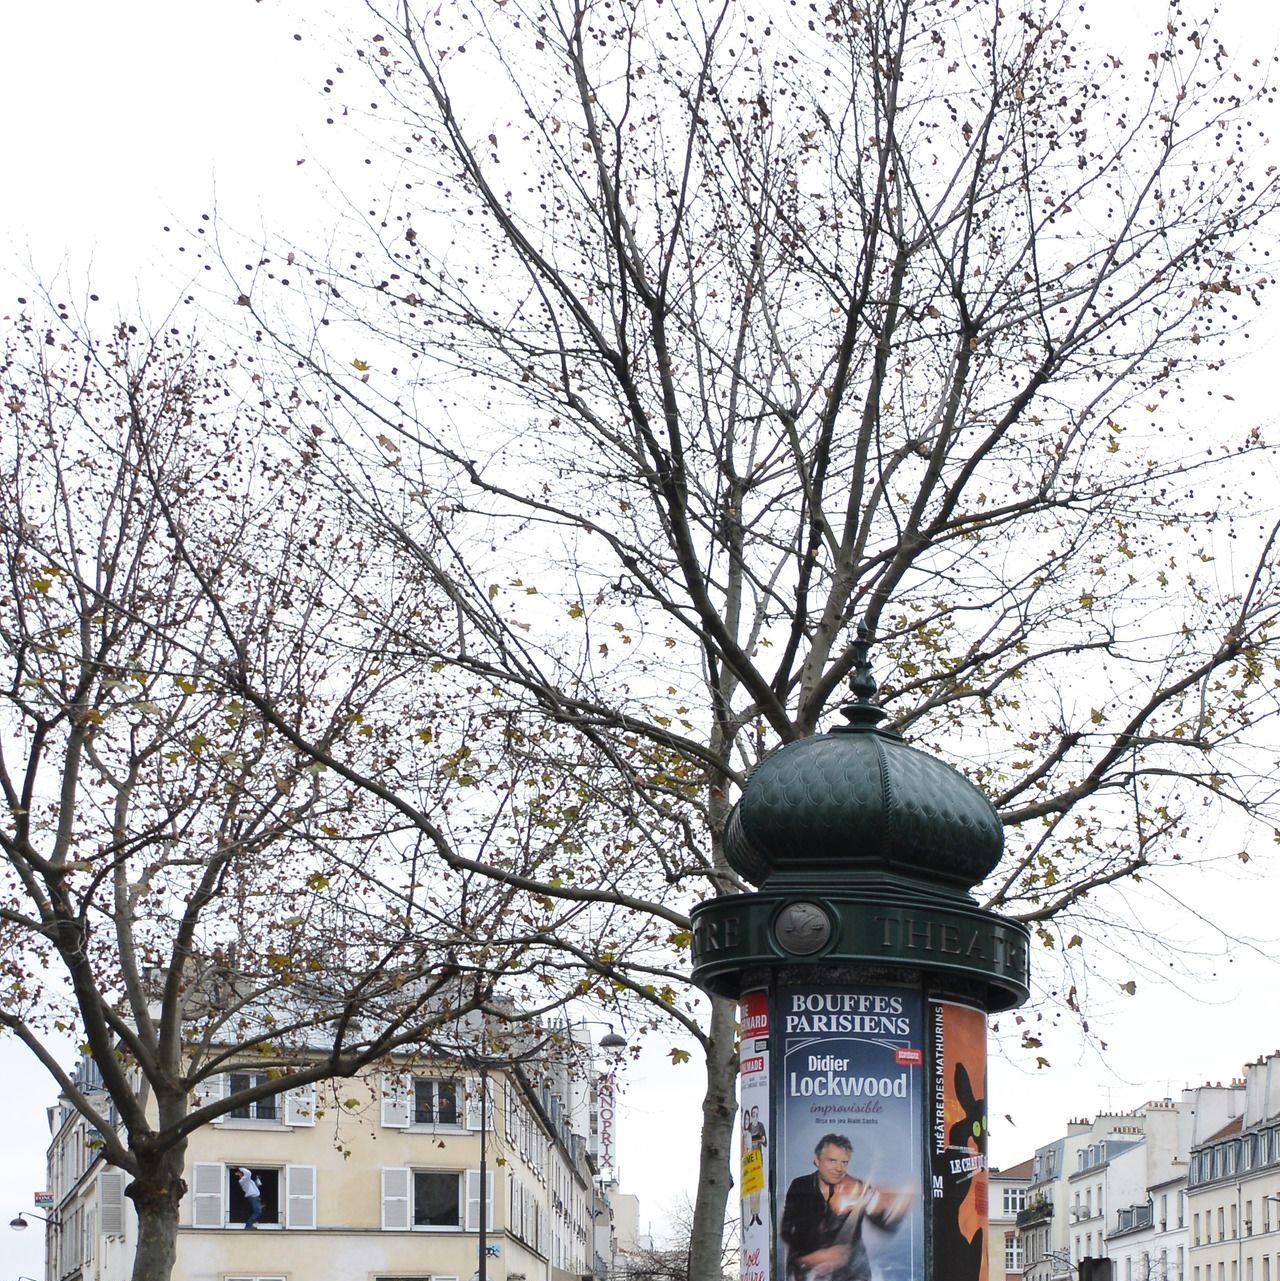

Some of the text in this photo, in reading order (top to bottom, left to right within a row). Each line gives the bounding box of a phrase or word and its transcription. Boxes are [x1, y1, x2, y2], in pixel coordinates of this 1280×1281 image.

[792, 994, 903, 1014] BOUFFES
[786, 1015, 910, 1035] PARISIENS
[808, 1055, 850, 1071] Didier
[791, 1071, 907, 1098] Lockwood
[935, 1006, 945, 1155] THÉÂTRE DES MATHURINS
[810, 1100, 882, 1116] improvisible
[599, 1071, 615, 1168] MONOPRIX
[950, 1160, 960, 1173] LE
